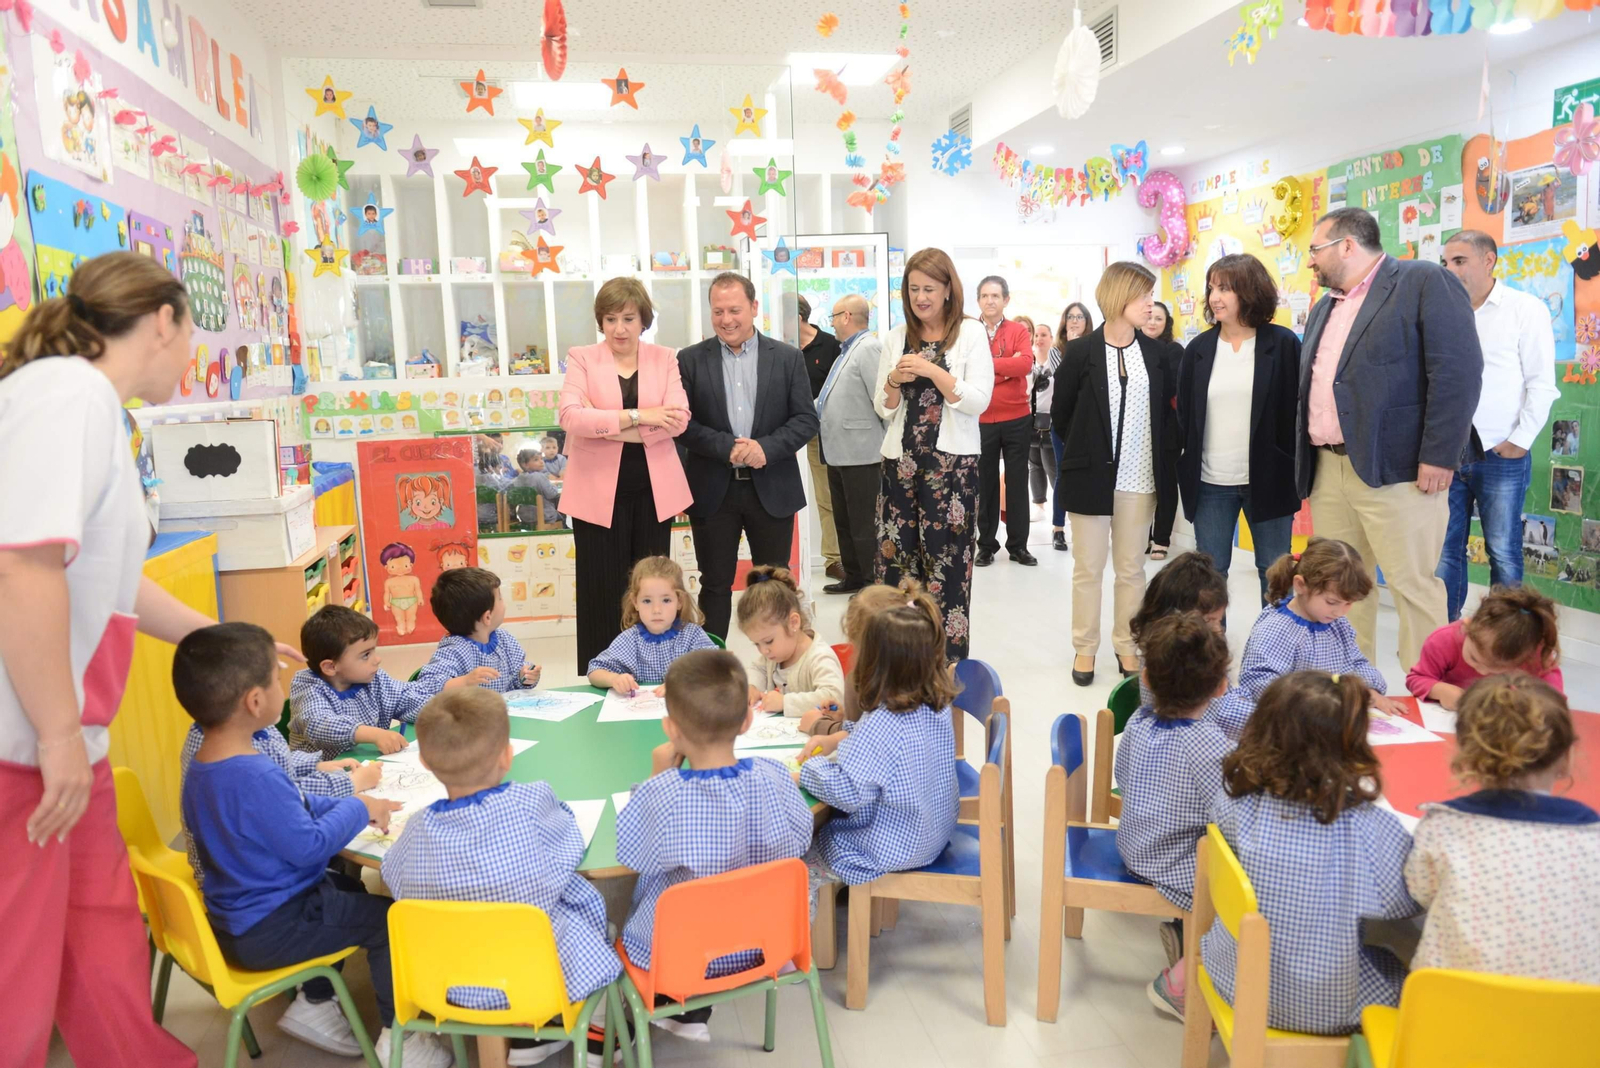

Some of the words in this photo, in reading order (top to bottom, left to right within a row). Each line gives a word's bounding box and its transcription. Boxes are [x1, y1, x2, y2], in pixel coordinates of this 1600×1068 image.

[70, 0, 263, 144] AMBLEA
[1346, 150, 1404, 181] CENTRO
[1418, 144, 1443, 167] DE
[1362, 170, 1434, 209] INTERES
[302, 390, 412, 414] PRAXIAS
[372, 446, 397, 463] EL
[400, 440, 464, 462] CUERPO
